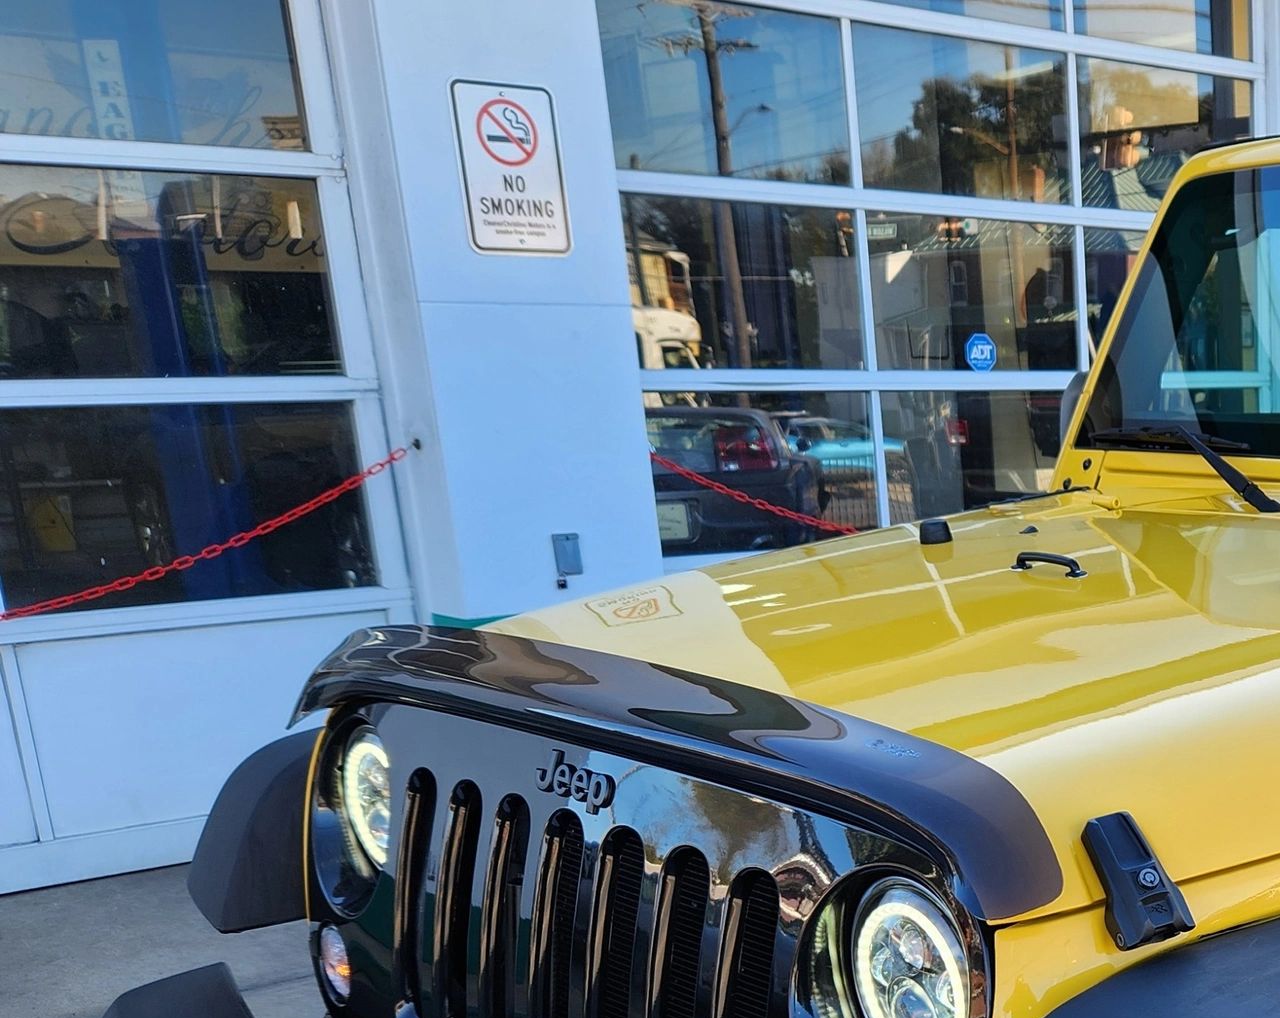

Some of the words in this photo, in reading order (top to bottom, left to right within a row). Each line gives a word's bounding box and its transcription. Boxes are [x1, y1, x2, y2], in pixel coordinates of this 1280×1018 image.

[503, 174, 526, 193] NO
[480, 197, 554, 218] SMOKING
[971, 345, 993, 360] ADT
[536, 748, 616, 815] Jeep
